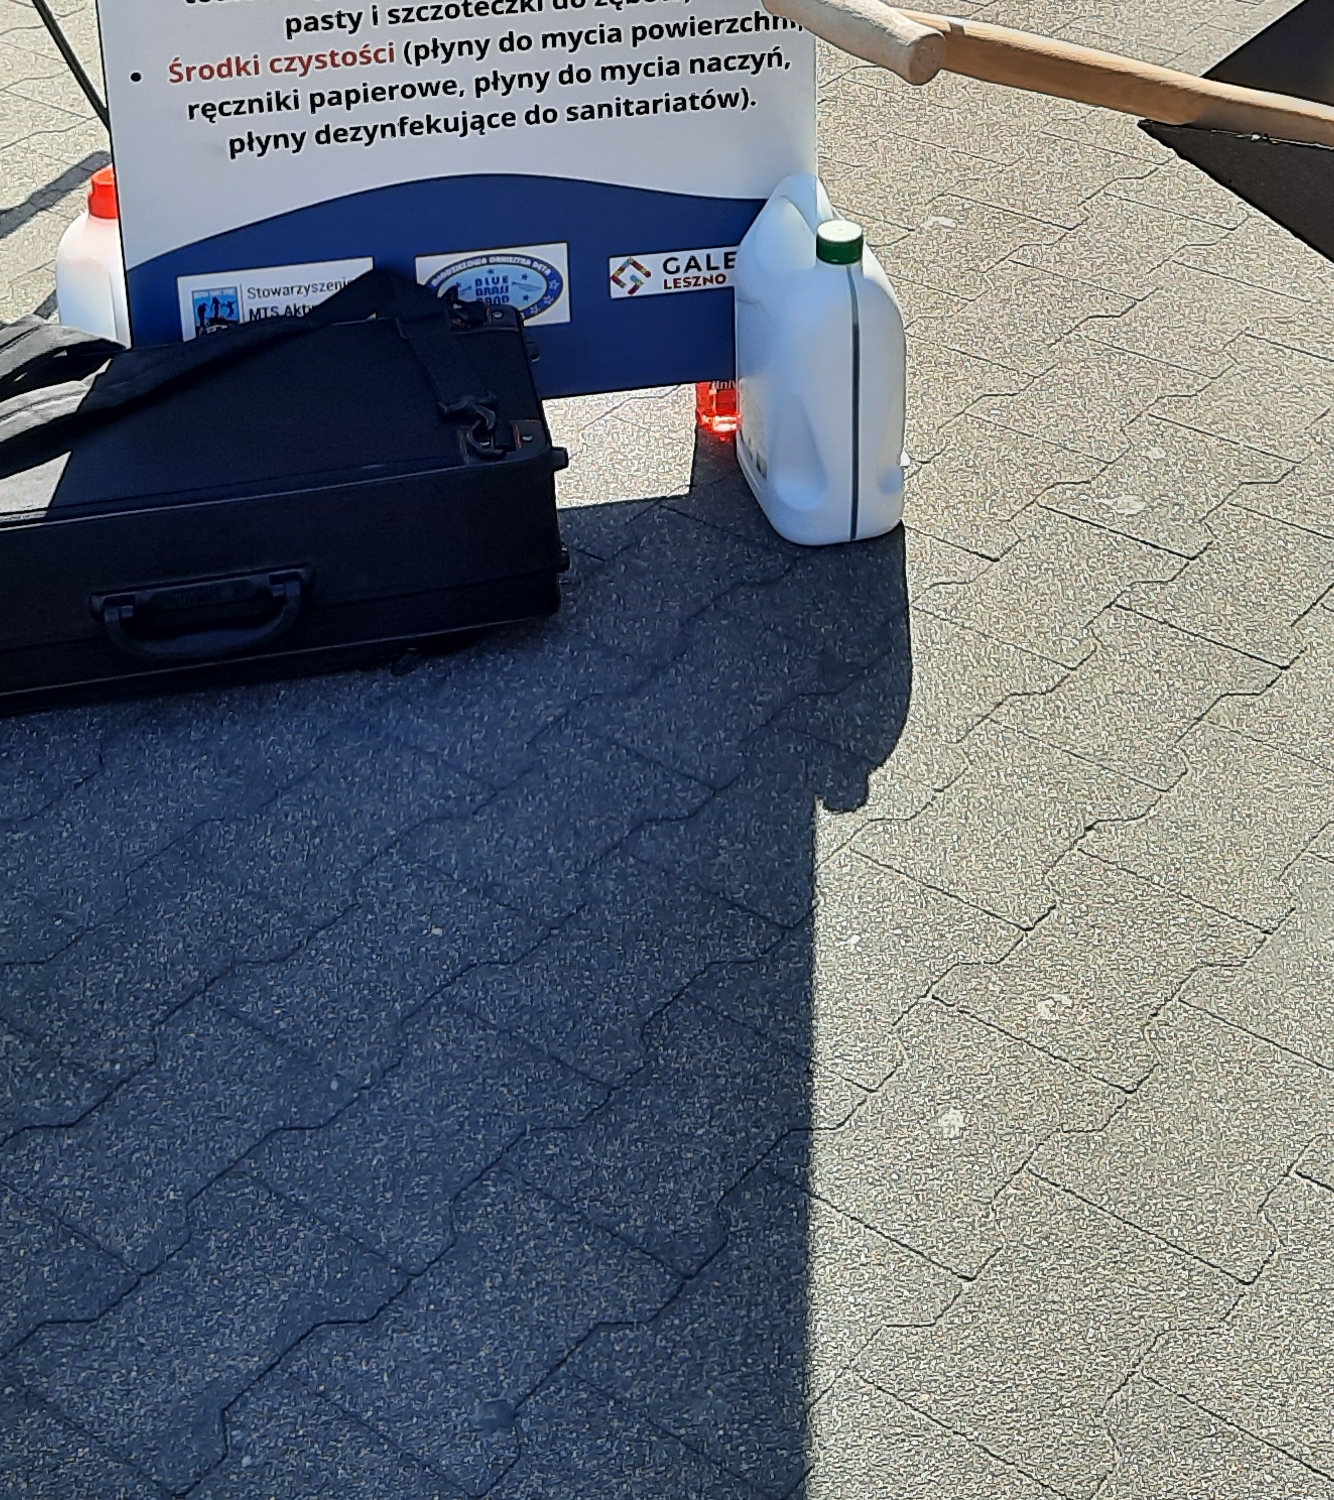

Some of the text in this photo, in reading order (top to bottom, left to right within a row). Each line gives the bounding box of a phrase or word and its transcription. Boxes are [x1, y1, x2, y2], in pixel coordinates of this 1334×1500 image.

[285, 9, 364, 41] pasty
[371, 4, 380, 27] i
[168, 53, 261, 84] Środki
[269, 41, 395, 78] czystości
[403, 37, 492, 68] (płyny
[498, 30, 533, 54] do
[541, 22, 623, 54] mycia
[187, 45, 791, 124] ręczniki papierowe, płyny do mycia naczyń,
[228, 86, 757, 161] płyny dezynfekujące do sanitariatów).
[662, 250, 738, 275] GALE
[474, 275, 509, 287] BLUE
[475, 285, 509, 296] BRASS
[663, 273, 727, 290] LESZNO
